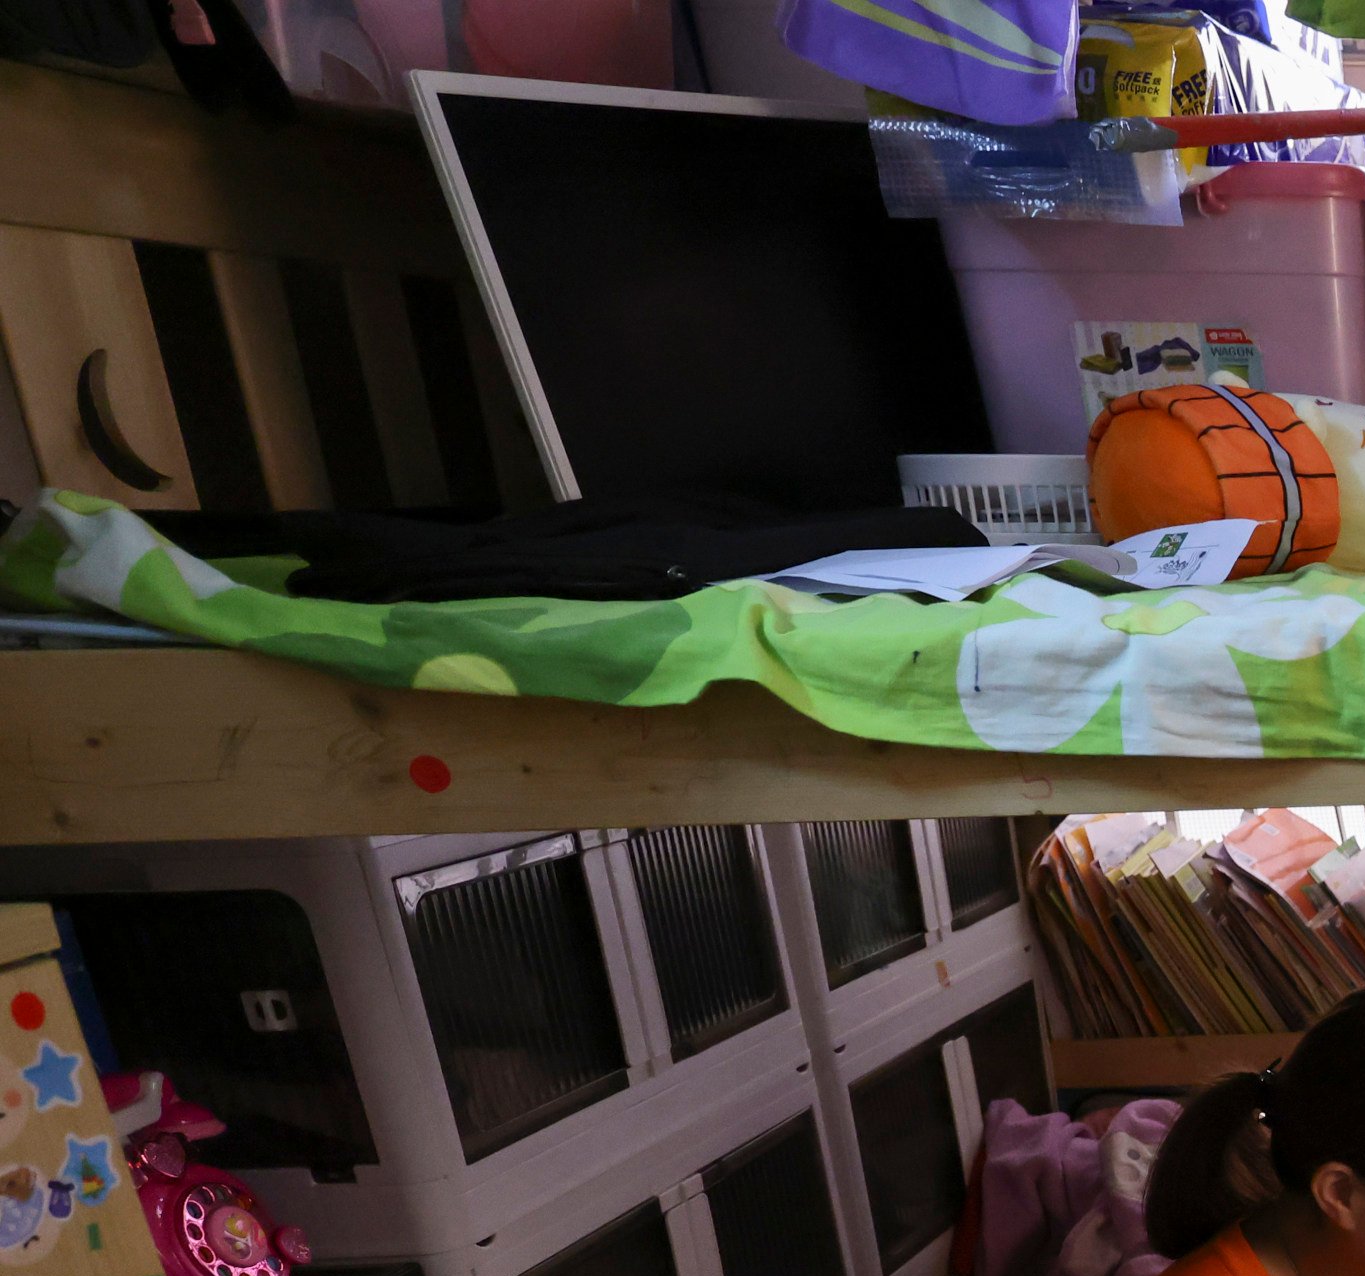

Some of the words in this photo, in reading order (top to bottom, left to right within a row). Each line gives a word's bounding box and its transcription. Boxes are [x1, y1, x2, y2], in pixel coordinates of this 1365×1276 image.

[1114, 70, 1153, 85] FREE
[1112, 81, 1161, 96] Softpack
[1171, 69, 1207, 109] FREE
[1210, 346, 1254, 357] WAGON
